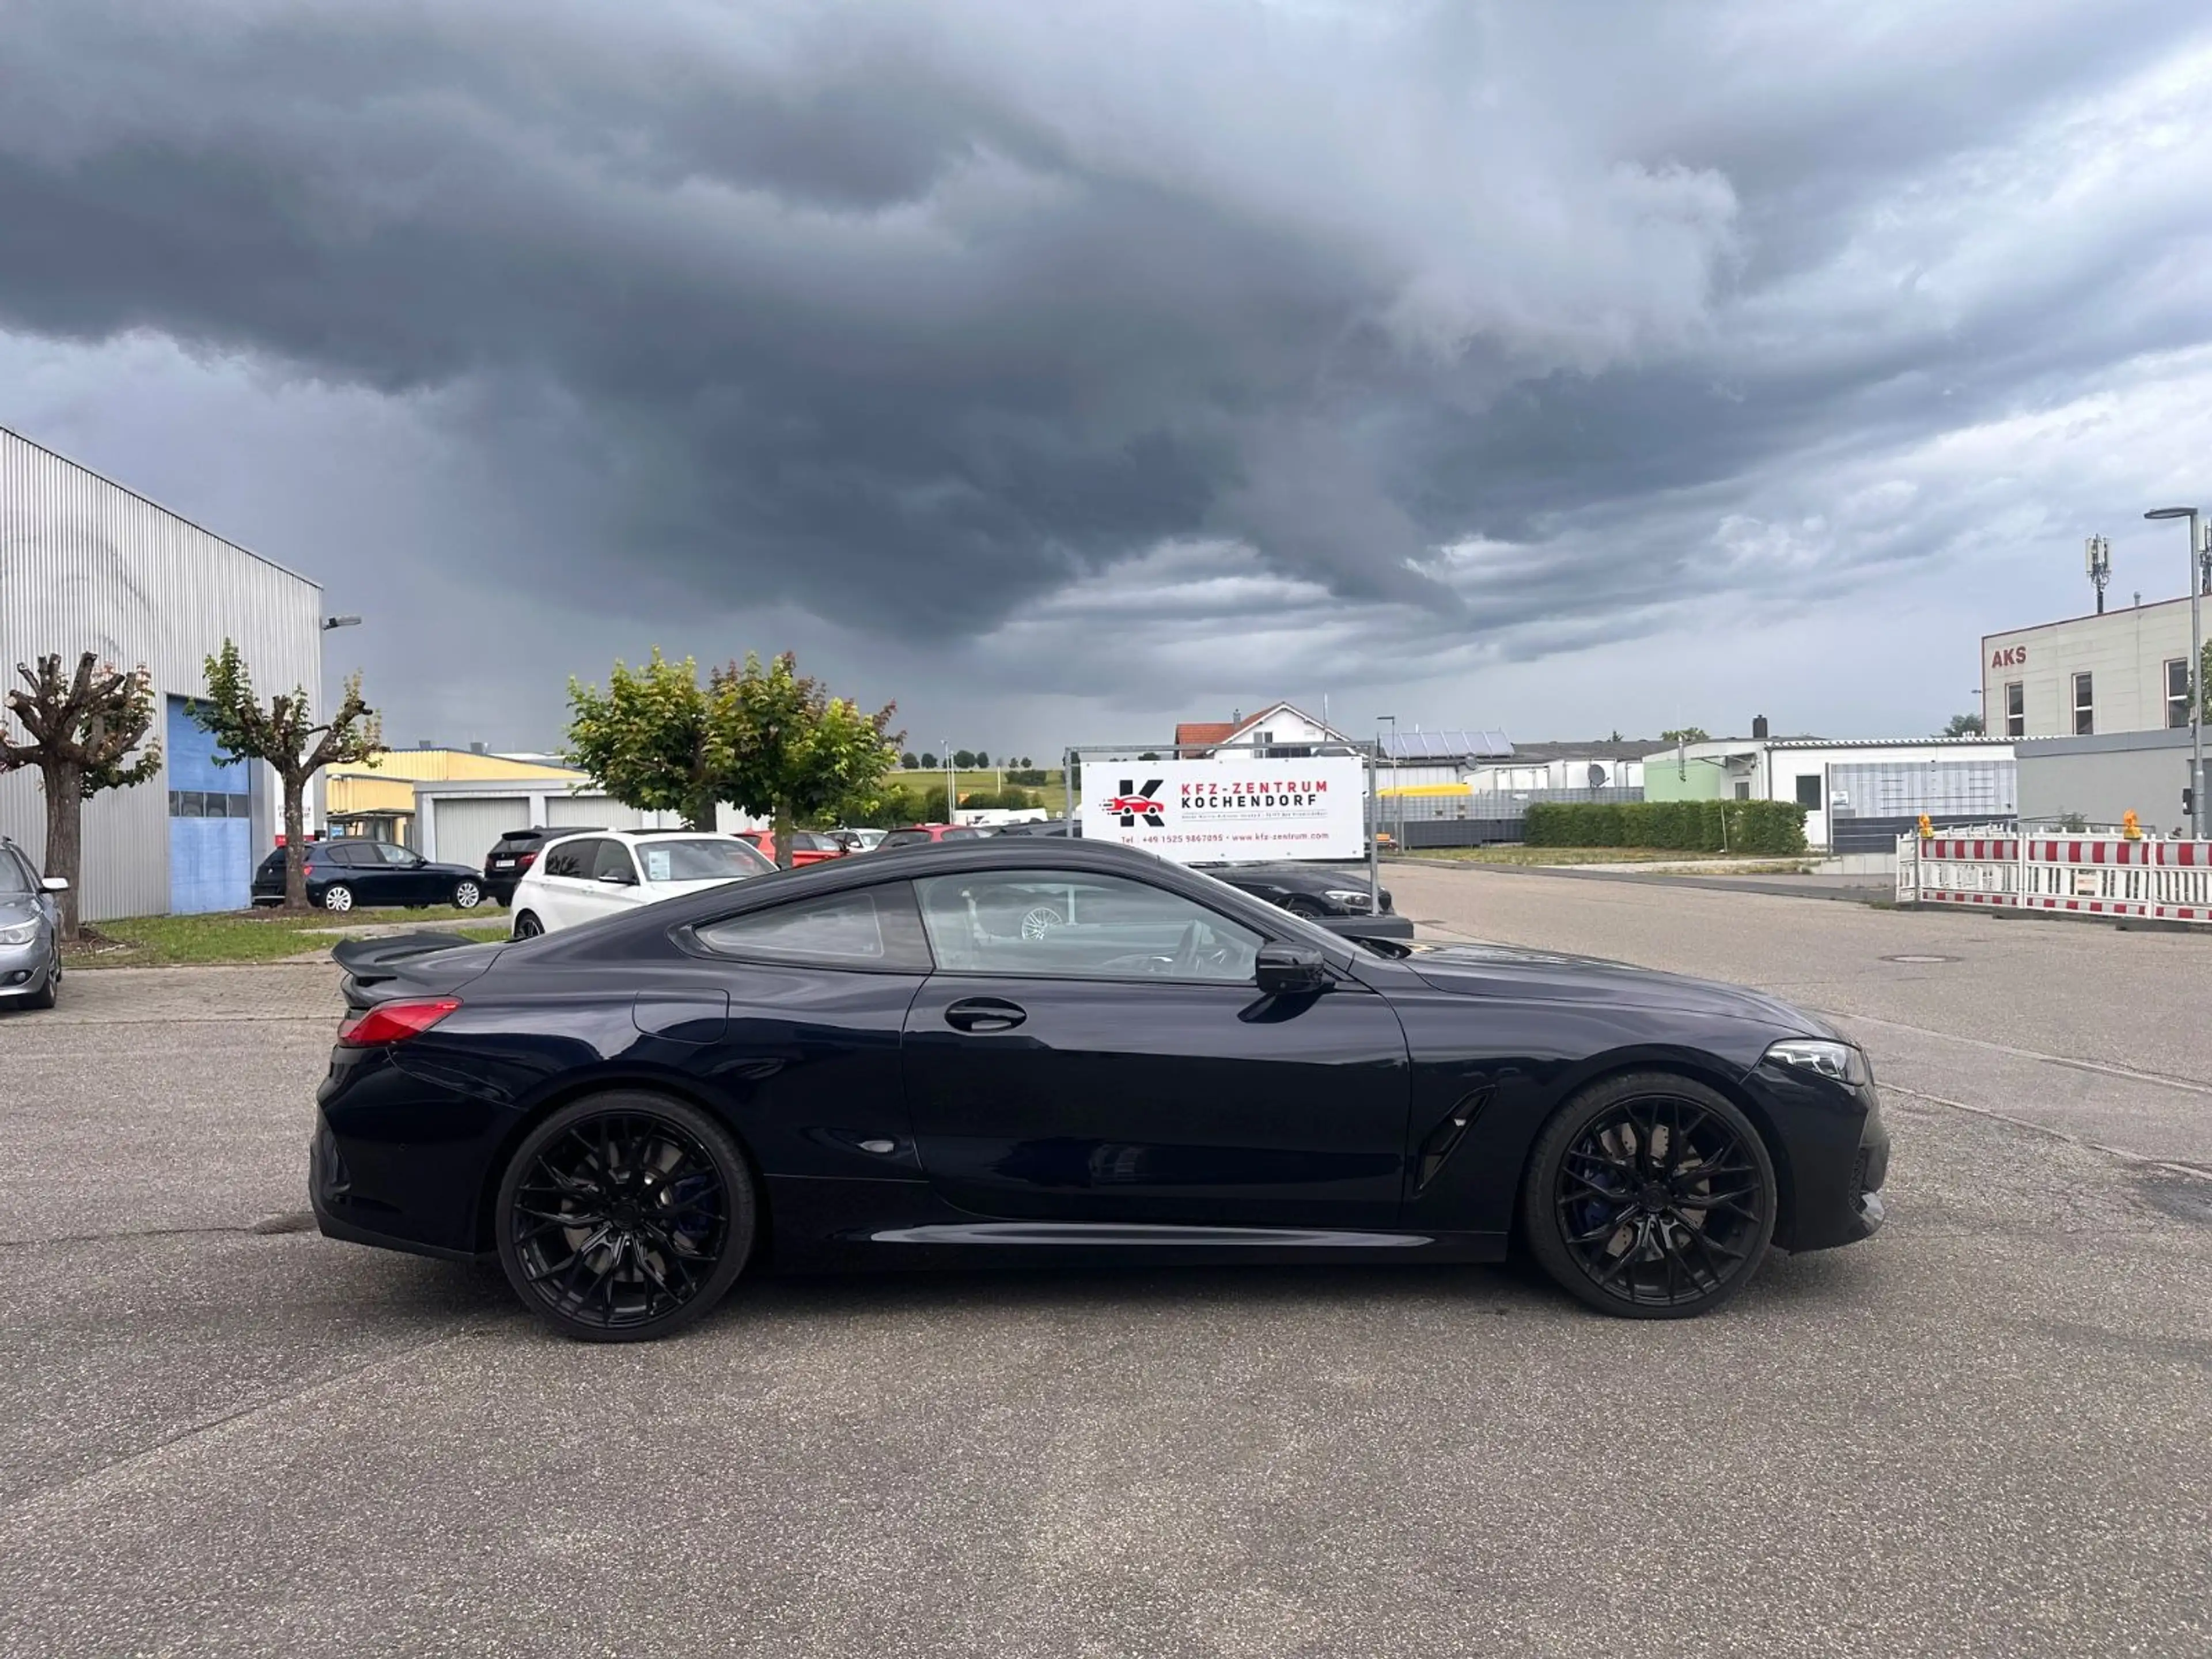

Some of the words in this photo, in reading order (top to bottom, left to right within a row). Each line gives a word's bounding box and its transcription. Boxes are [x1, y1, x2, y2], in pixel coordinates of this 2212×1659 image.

[1992, 646, 2026, 668] AKS
[1181, 781, 1327, 796] KFZ-ZENTRUM
[1181, 794, 1317, 809] KOCHENDORF
[1232, 832, 1329, 841] www.kfz-zentrum.com
